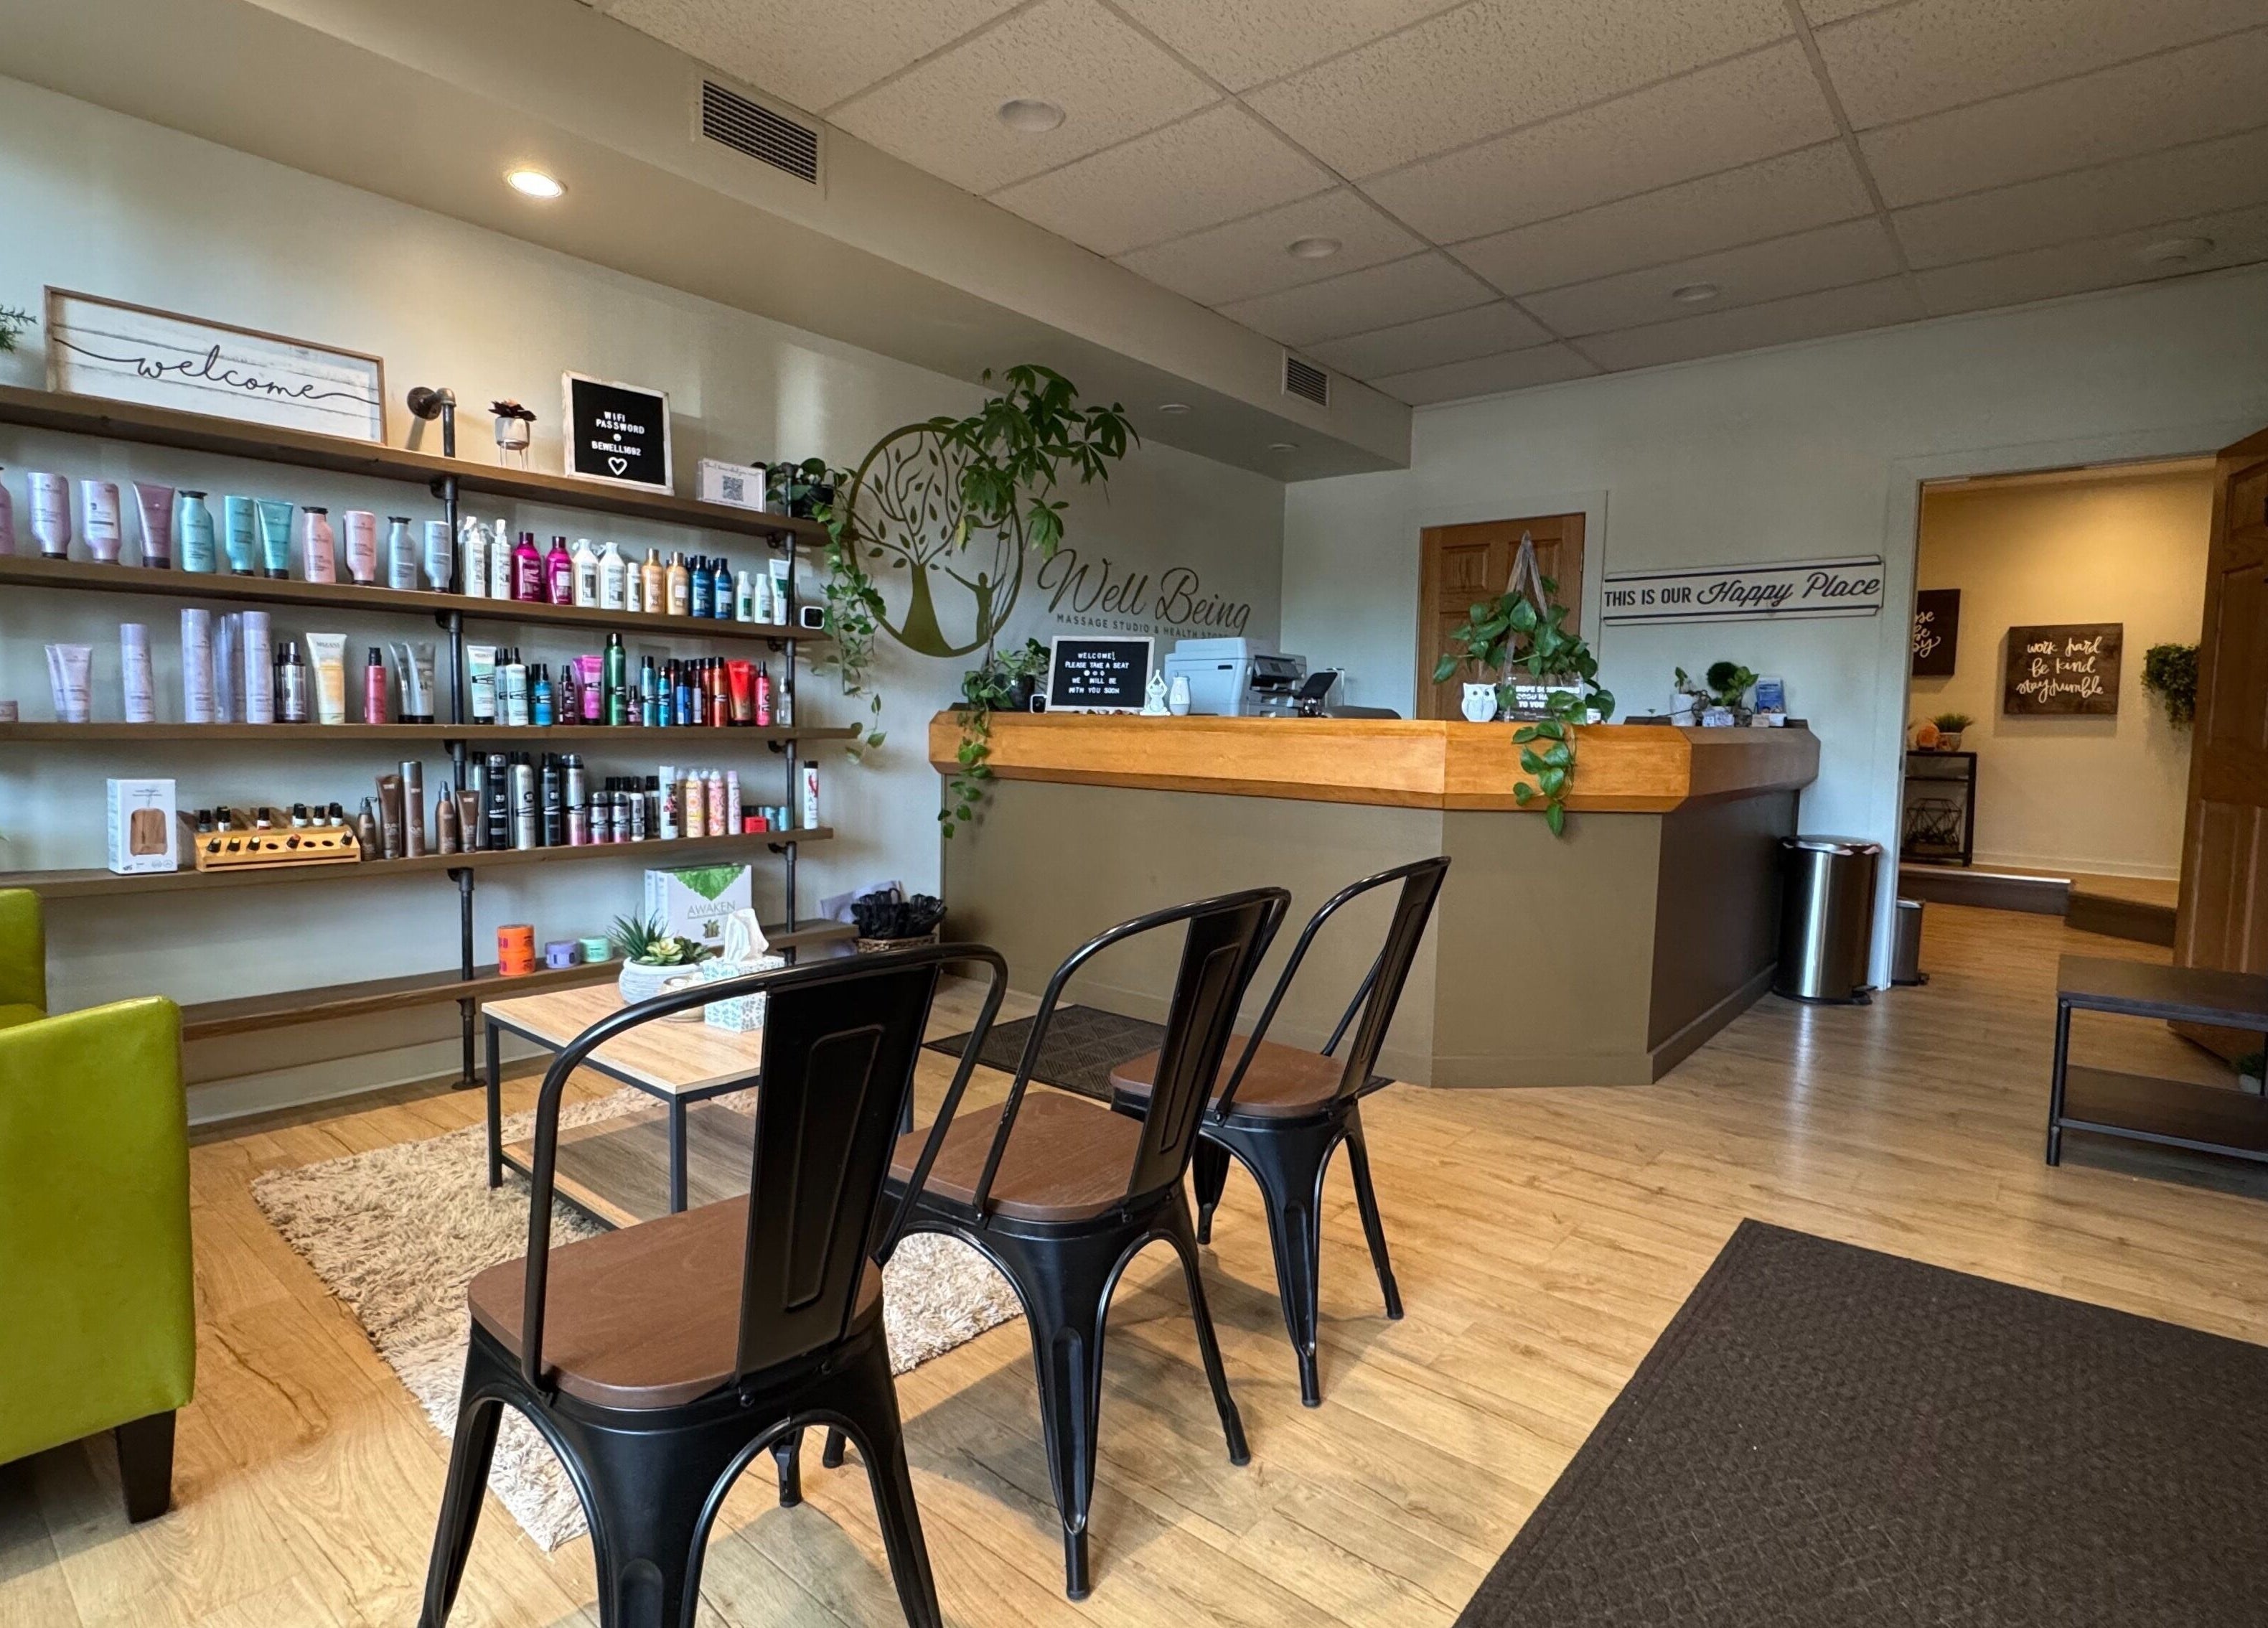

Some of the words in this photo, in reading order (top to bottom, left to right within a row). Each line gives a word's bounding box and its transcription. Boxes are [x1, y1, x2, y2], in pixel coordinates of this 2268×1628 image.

[596, 418, 645, 434] PASSWORD
[1037, 548, 1149, 615] Well
[1155, 567, 1251, 637] Being
[1604, 590, 1636, 607] THIS
[1641, 589, 1655, 605] IS
[1661, 587, 1692, 604] OUR
[1697, 580, 1794, 607] Happy
[1801, 572, 1880, 599] Place
[1056, 614, 1109, 629] MASSAGE
[1112, 619, 1150, 633] STUDIO
[1163, 625, 1197, 638] HEALTH
[1077, 651, 1116, 661] WELCOME!
[2027, 641, 2058, 655] work
[2065, 636, 2103, 657] hard
[1064, 660, 1087, 669] PLEASE
[2028, 658, 2050, 678] be
[2056, 656, 2096, 674] kind
[2015, 679, 2048, 703] stay
[2048, 675, 2104, 698] humble
[688, 901, 736, 916] AWAKEN
